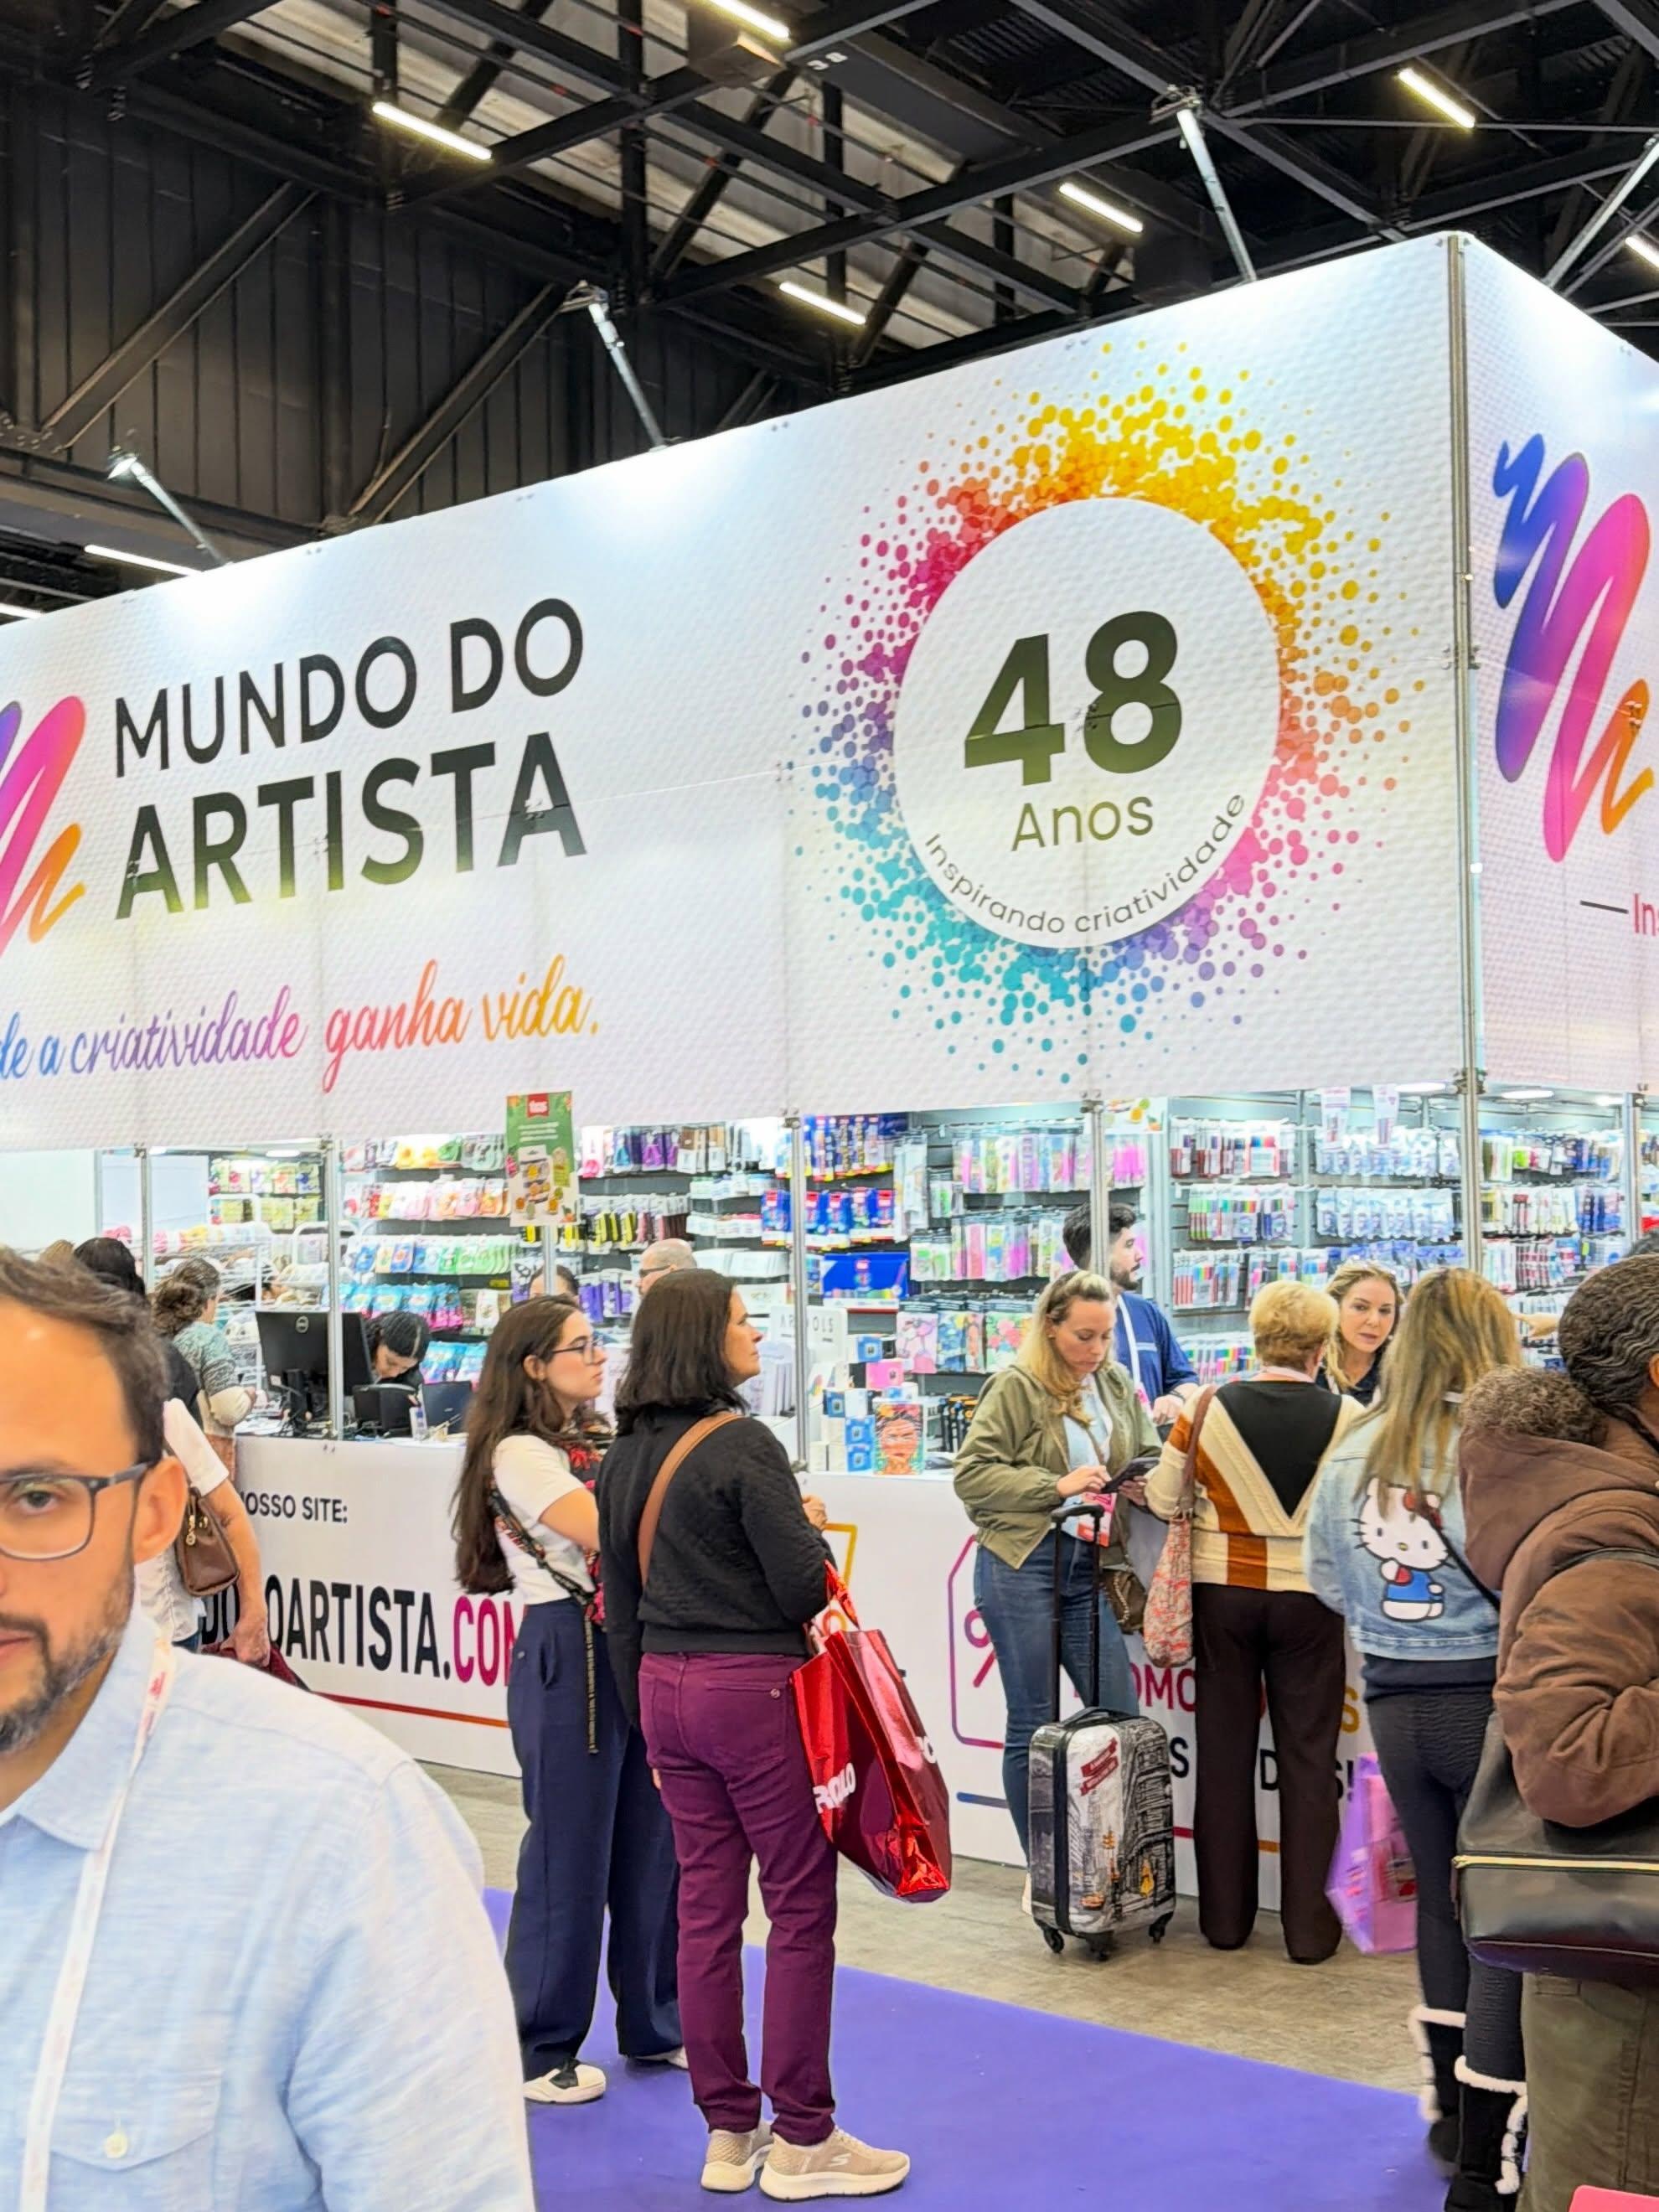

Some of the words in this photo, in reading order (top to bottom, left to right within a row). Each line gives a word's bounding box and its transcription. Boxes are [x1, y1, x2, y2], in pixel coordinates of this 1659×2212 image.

[116, 636, 418, 778] MUNDO
[450, 597, 583, 714] DO
[964, 610, 1183, 787] 48
[115, 731, 587, 920] ARTISTA
[925, 832, 1065, 933] Inspirando
[1074, 794, 1245, 933] criatividade
[1010, 796, 1154, 851] Anos
[1634, 892, 1659, 937] In
[39, 1035, 65, 1076] a
[70, 984, 309, 1074] criatividade
[322, 959, 472, 1093] ganha
[482, 954, 599, 1041] vida.
[302, 1496, 349, 1524] SITE:
